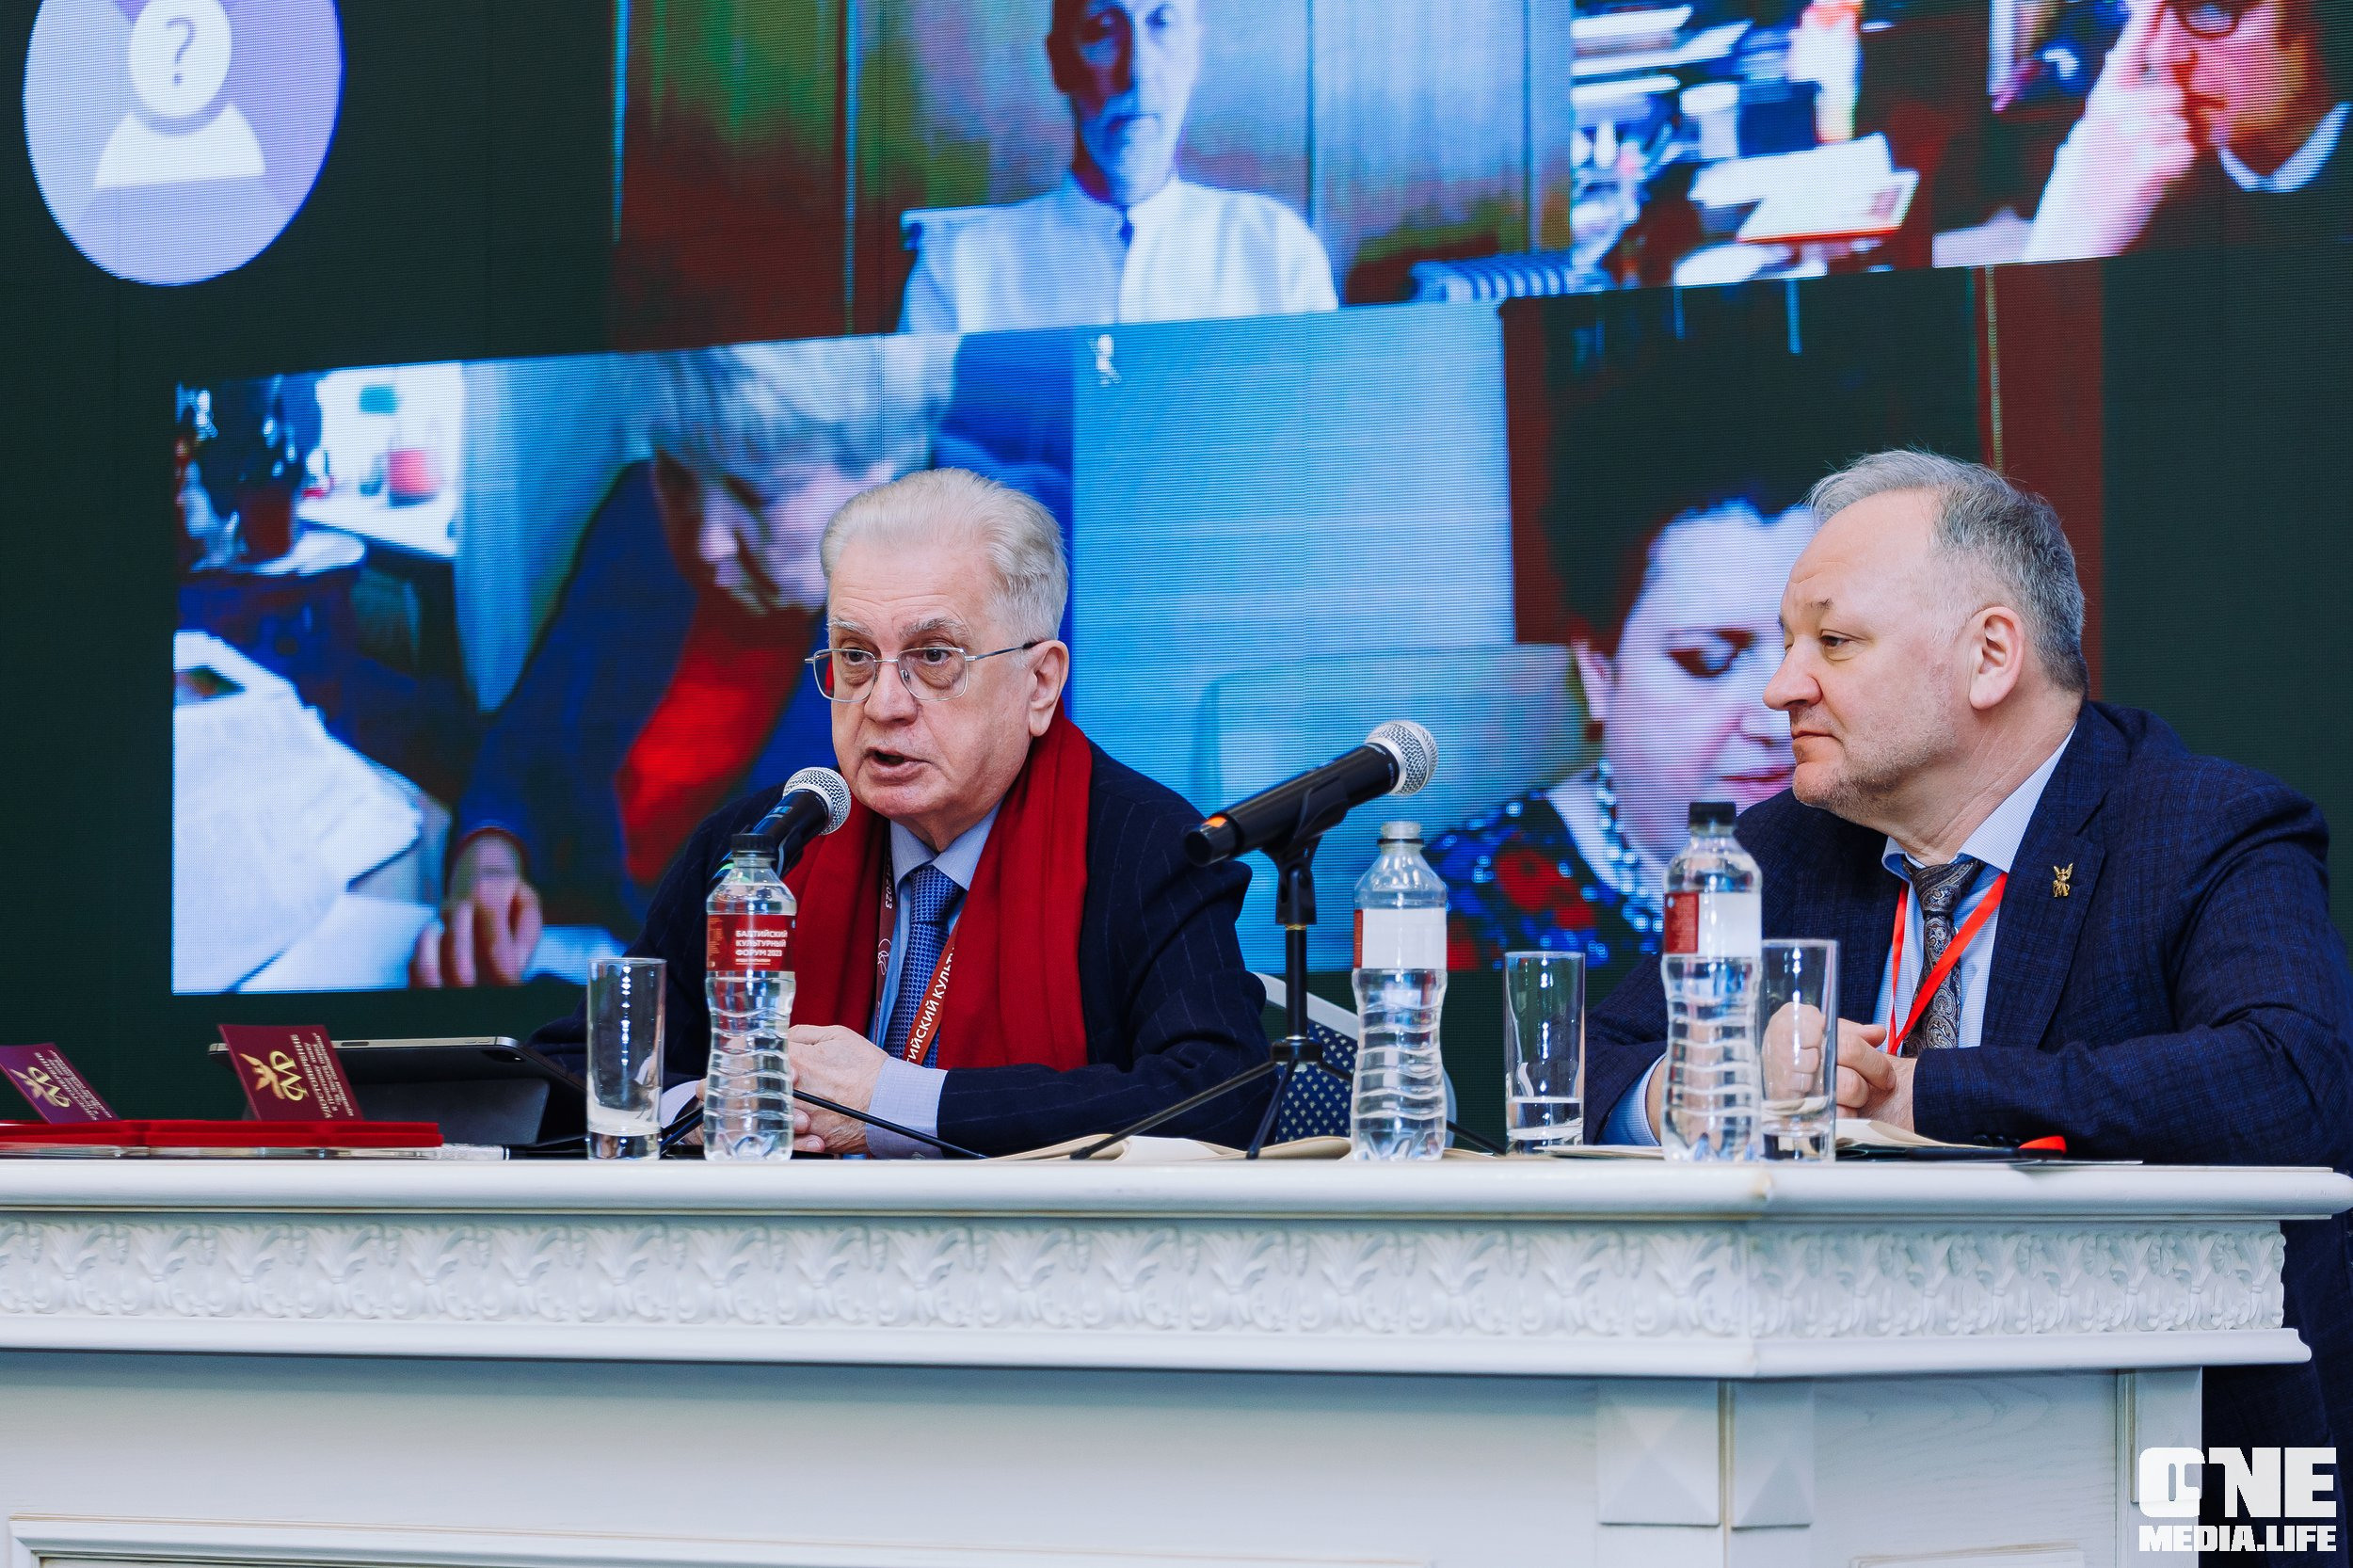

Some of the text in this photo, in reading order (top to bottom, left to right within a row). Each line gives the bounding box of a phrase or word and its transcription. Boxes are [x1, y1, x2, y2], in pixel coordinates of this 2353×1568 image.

[735, 929, 788, 937] БАЛТИЙСКИЙ
[735, 939, 787, 948] КУЛЬТУРНЫЙ
[289, 1033, 333, 1118] УДОСТОВЕРЕНИЕ
